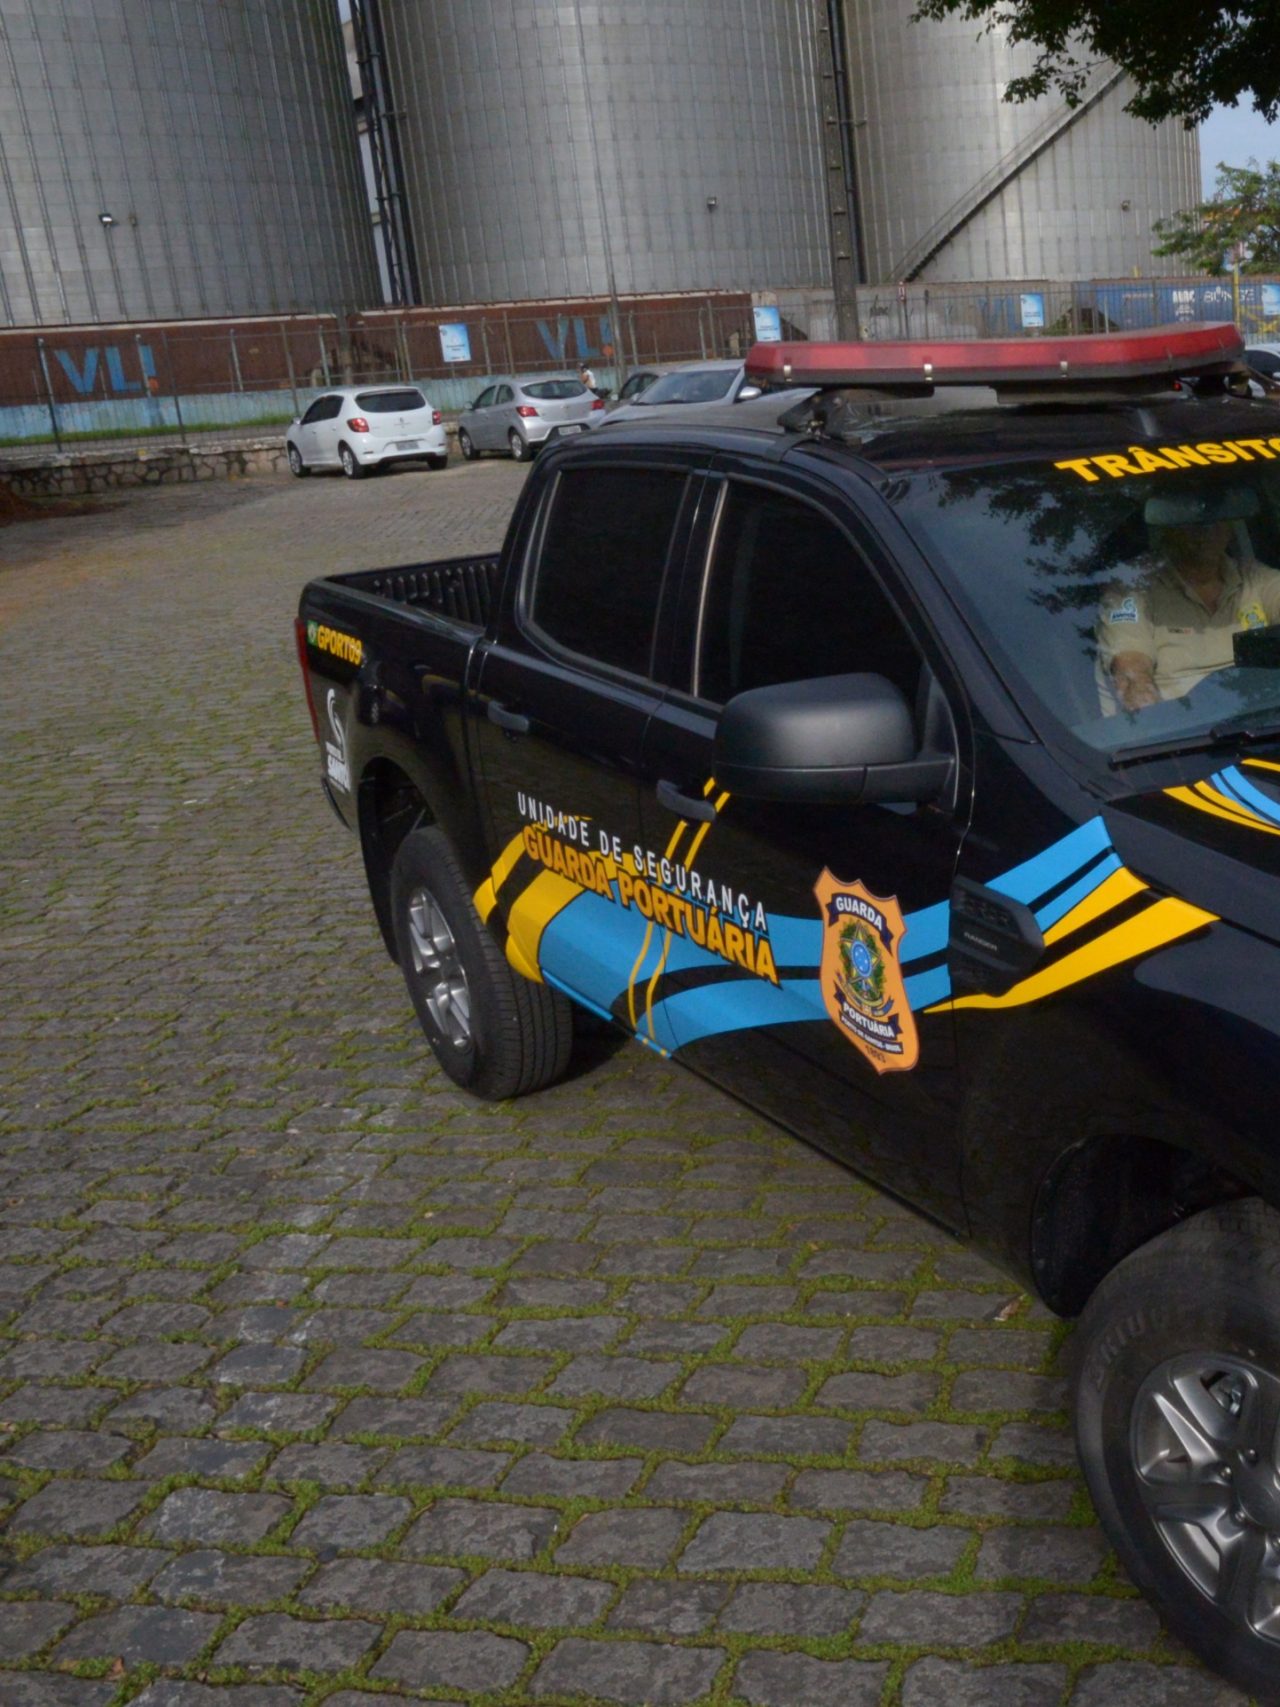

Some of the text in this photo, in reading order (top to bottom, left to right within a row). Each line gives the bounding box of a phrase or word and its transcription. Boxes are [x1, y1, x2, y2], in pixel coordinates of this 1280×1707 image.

[517, 791, 768, 931] UNIDADE DE SEGURANÇA
[522, 825, 782, 988] GUARDA PORTUÁRIA
[835, 896, 883, 931] GUARDA
